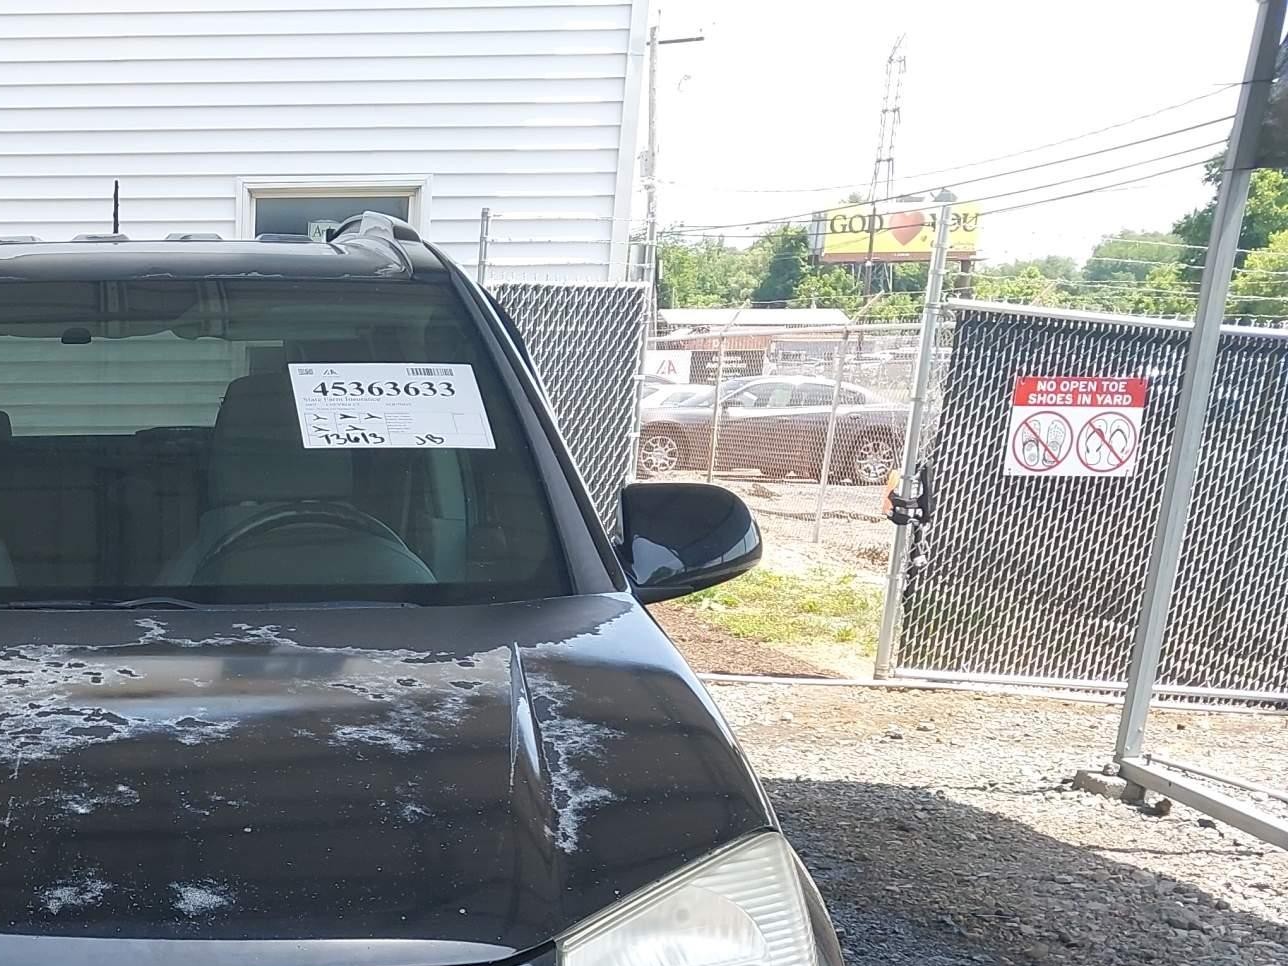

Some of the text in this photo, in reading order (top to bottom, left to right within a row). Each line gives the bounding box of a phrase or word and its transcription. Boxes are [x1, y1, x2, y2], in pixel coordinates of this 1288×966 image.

[830, 214, 883, 234] GOD
[313, 381, 456, 397] 45363633
[1036, 380, 1127, 392] NO OPEN TOE
[1028, 394, 1132, 406] SHOES IN YARD
